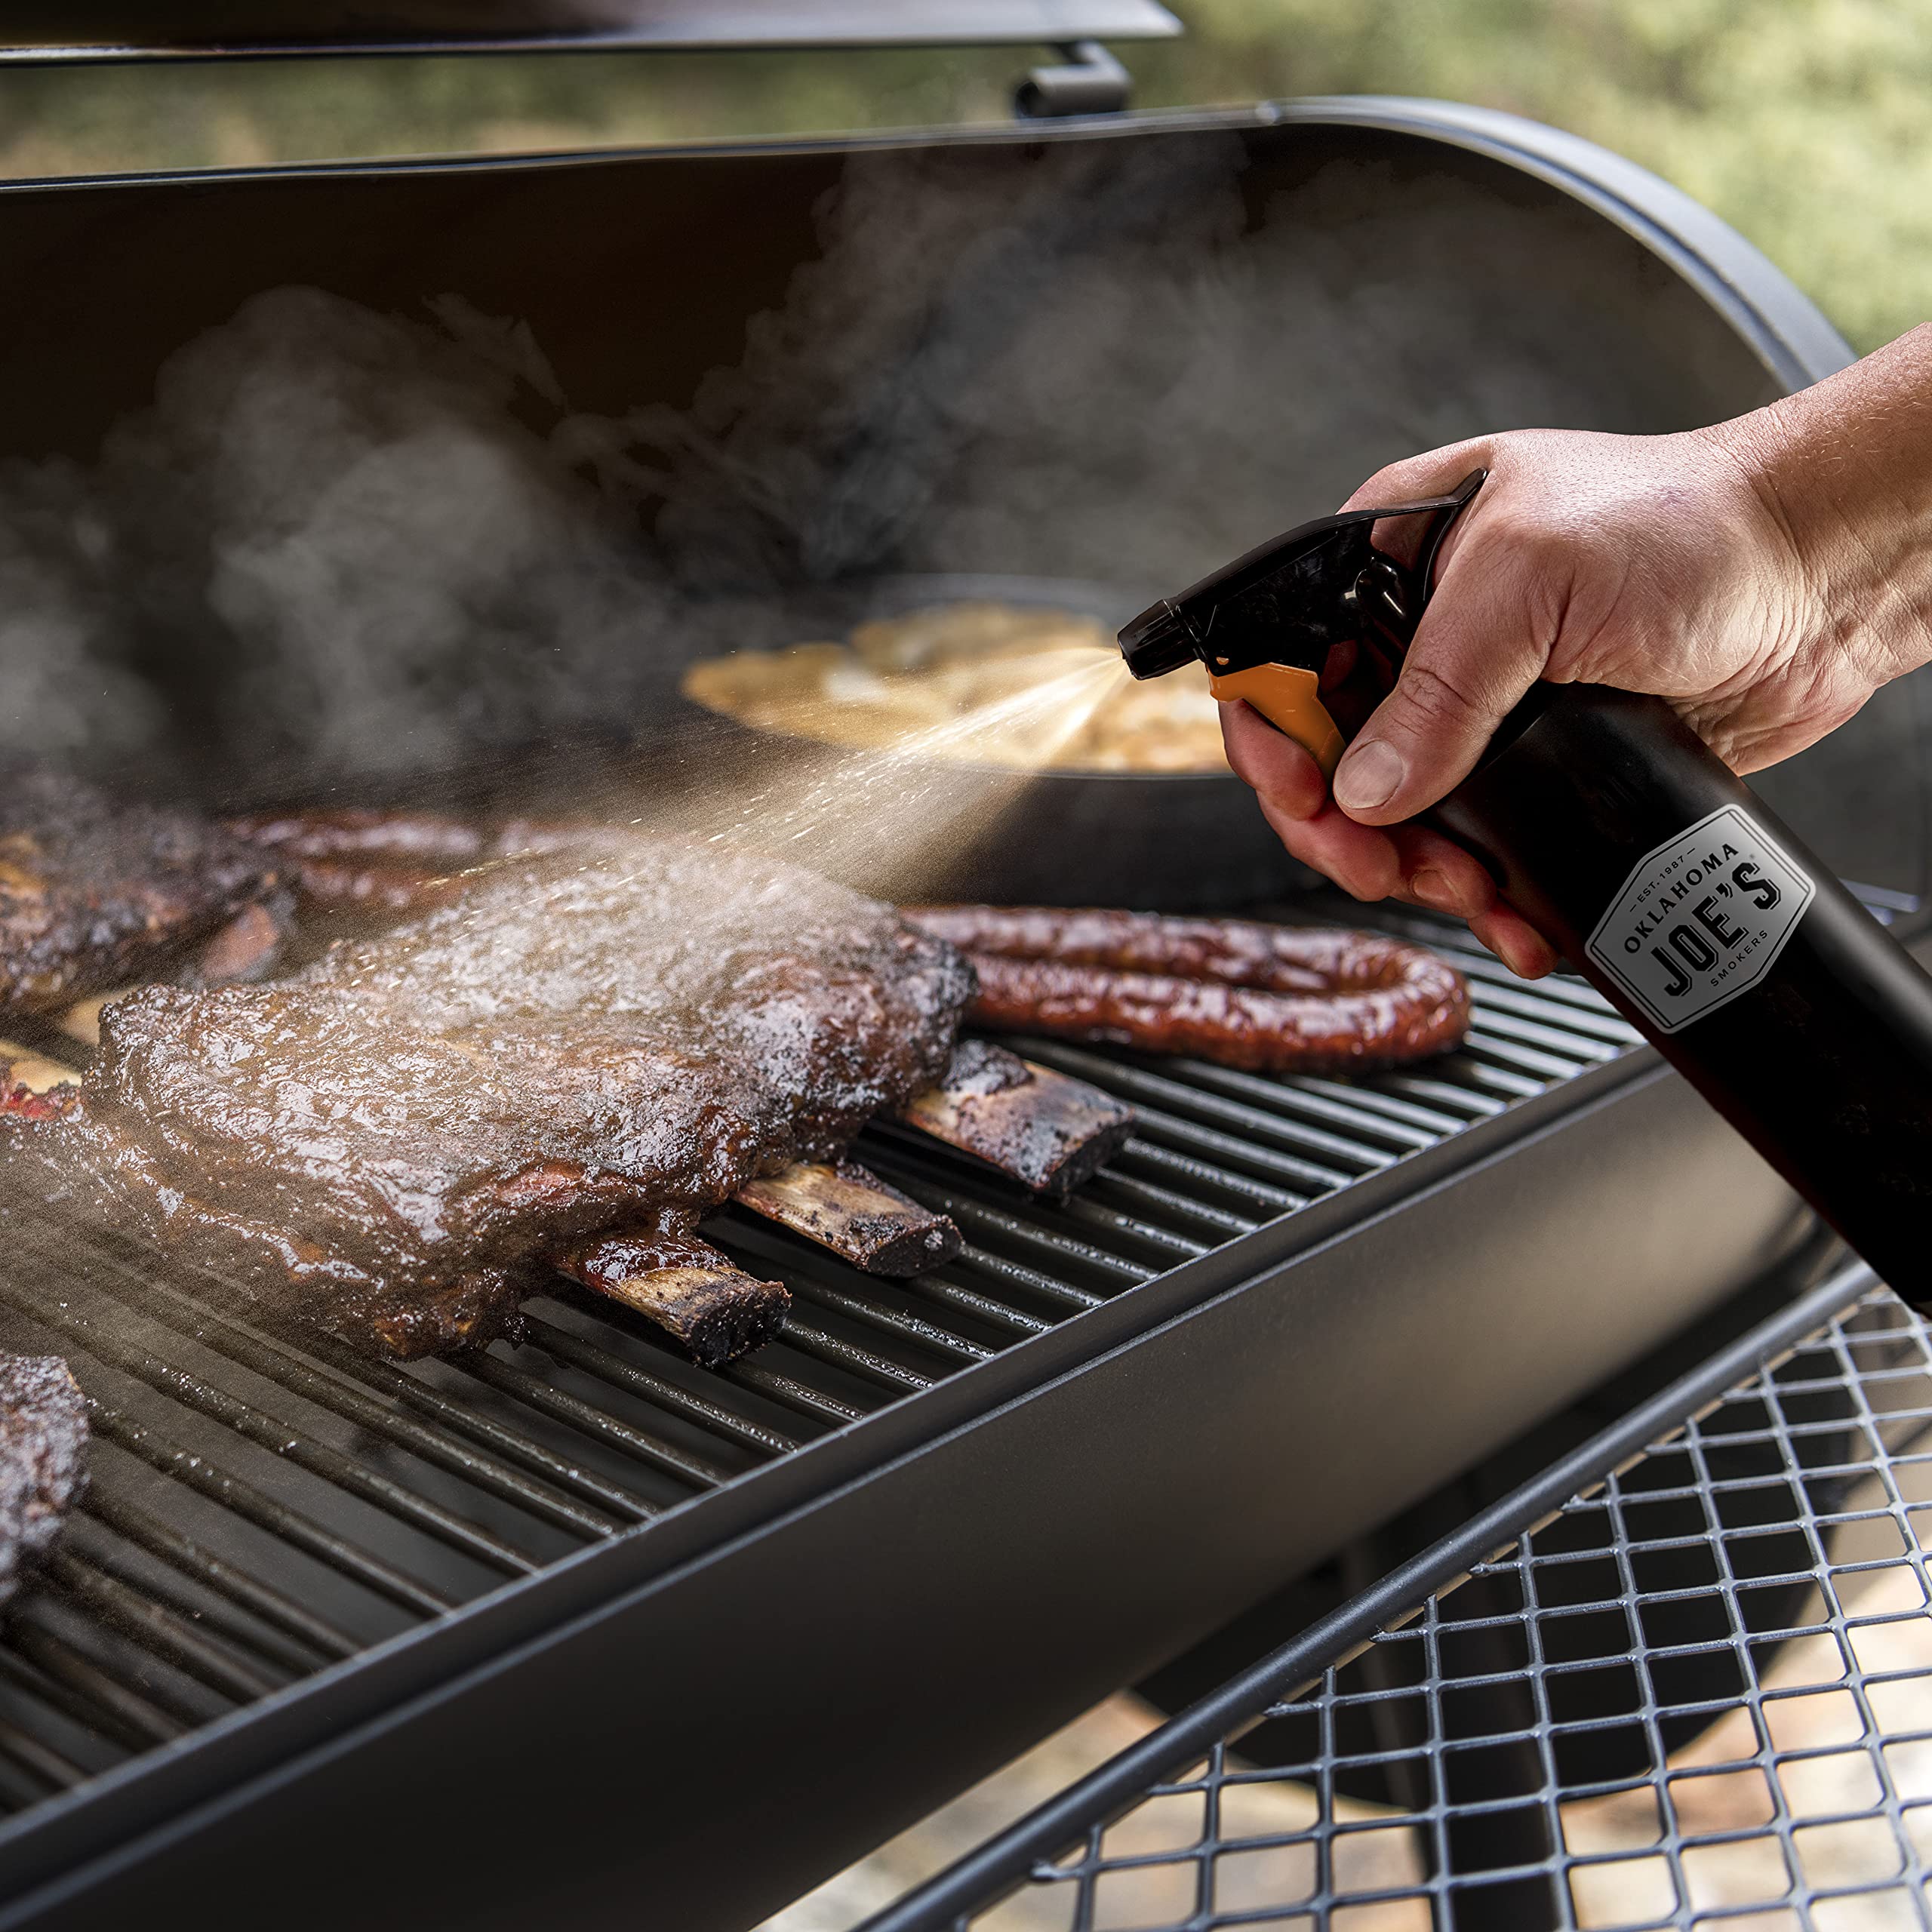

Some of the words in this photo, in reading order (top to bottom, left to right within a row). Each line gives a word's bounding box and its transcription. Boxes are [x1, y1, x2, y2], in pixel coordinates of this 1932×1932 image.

[1624, 844, 1739, 953] OKLAHOMA
[1637, 880, 1660, 903] EST.
[1660, 855, 1684, 879] 1987
[1651, 862, 1781, 997] JOE'S
[1710, 930, 1768, 987] SMOKERS
